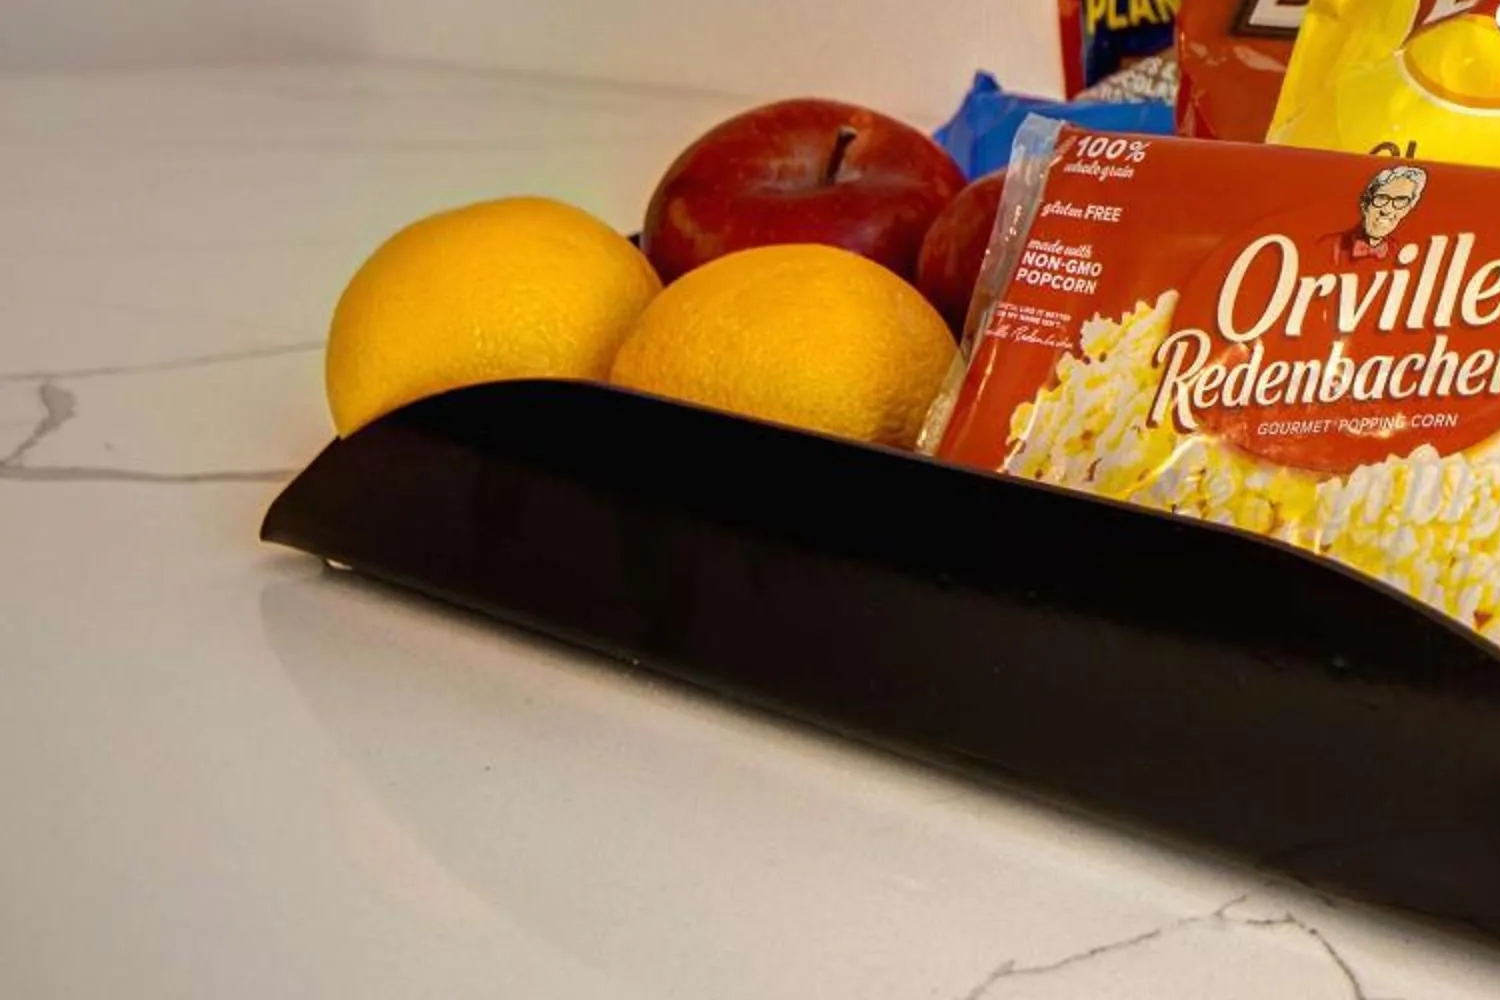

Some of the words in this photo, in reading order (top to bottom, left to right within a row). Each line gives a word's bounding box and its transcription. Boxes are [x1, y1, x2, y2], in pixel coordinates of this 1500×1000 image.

[1076, 136, 1149, 162] 100%
[1084, 205, 1122, 223] FREE
[1021, 251, 1102, 277] NON-GMO
[1016, 267, 1097, 294] POPCORN
[1257, 419, 1329, 436] GOURMET
[1338, 415, 1406, 433] POPPING
[1411, 413, 1459, 429] CORN
